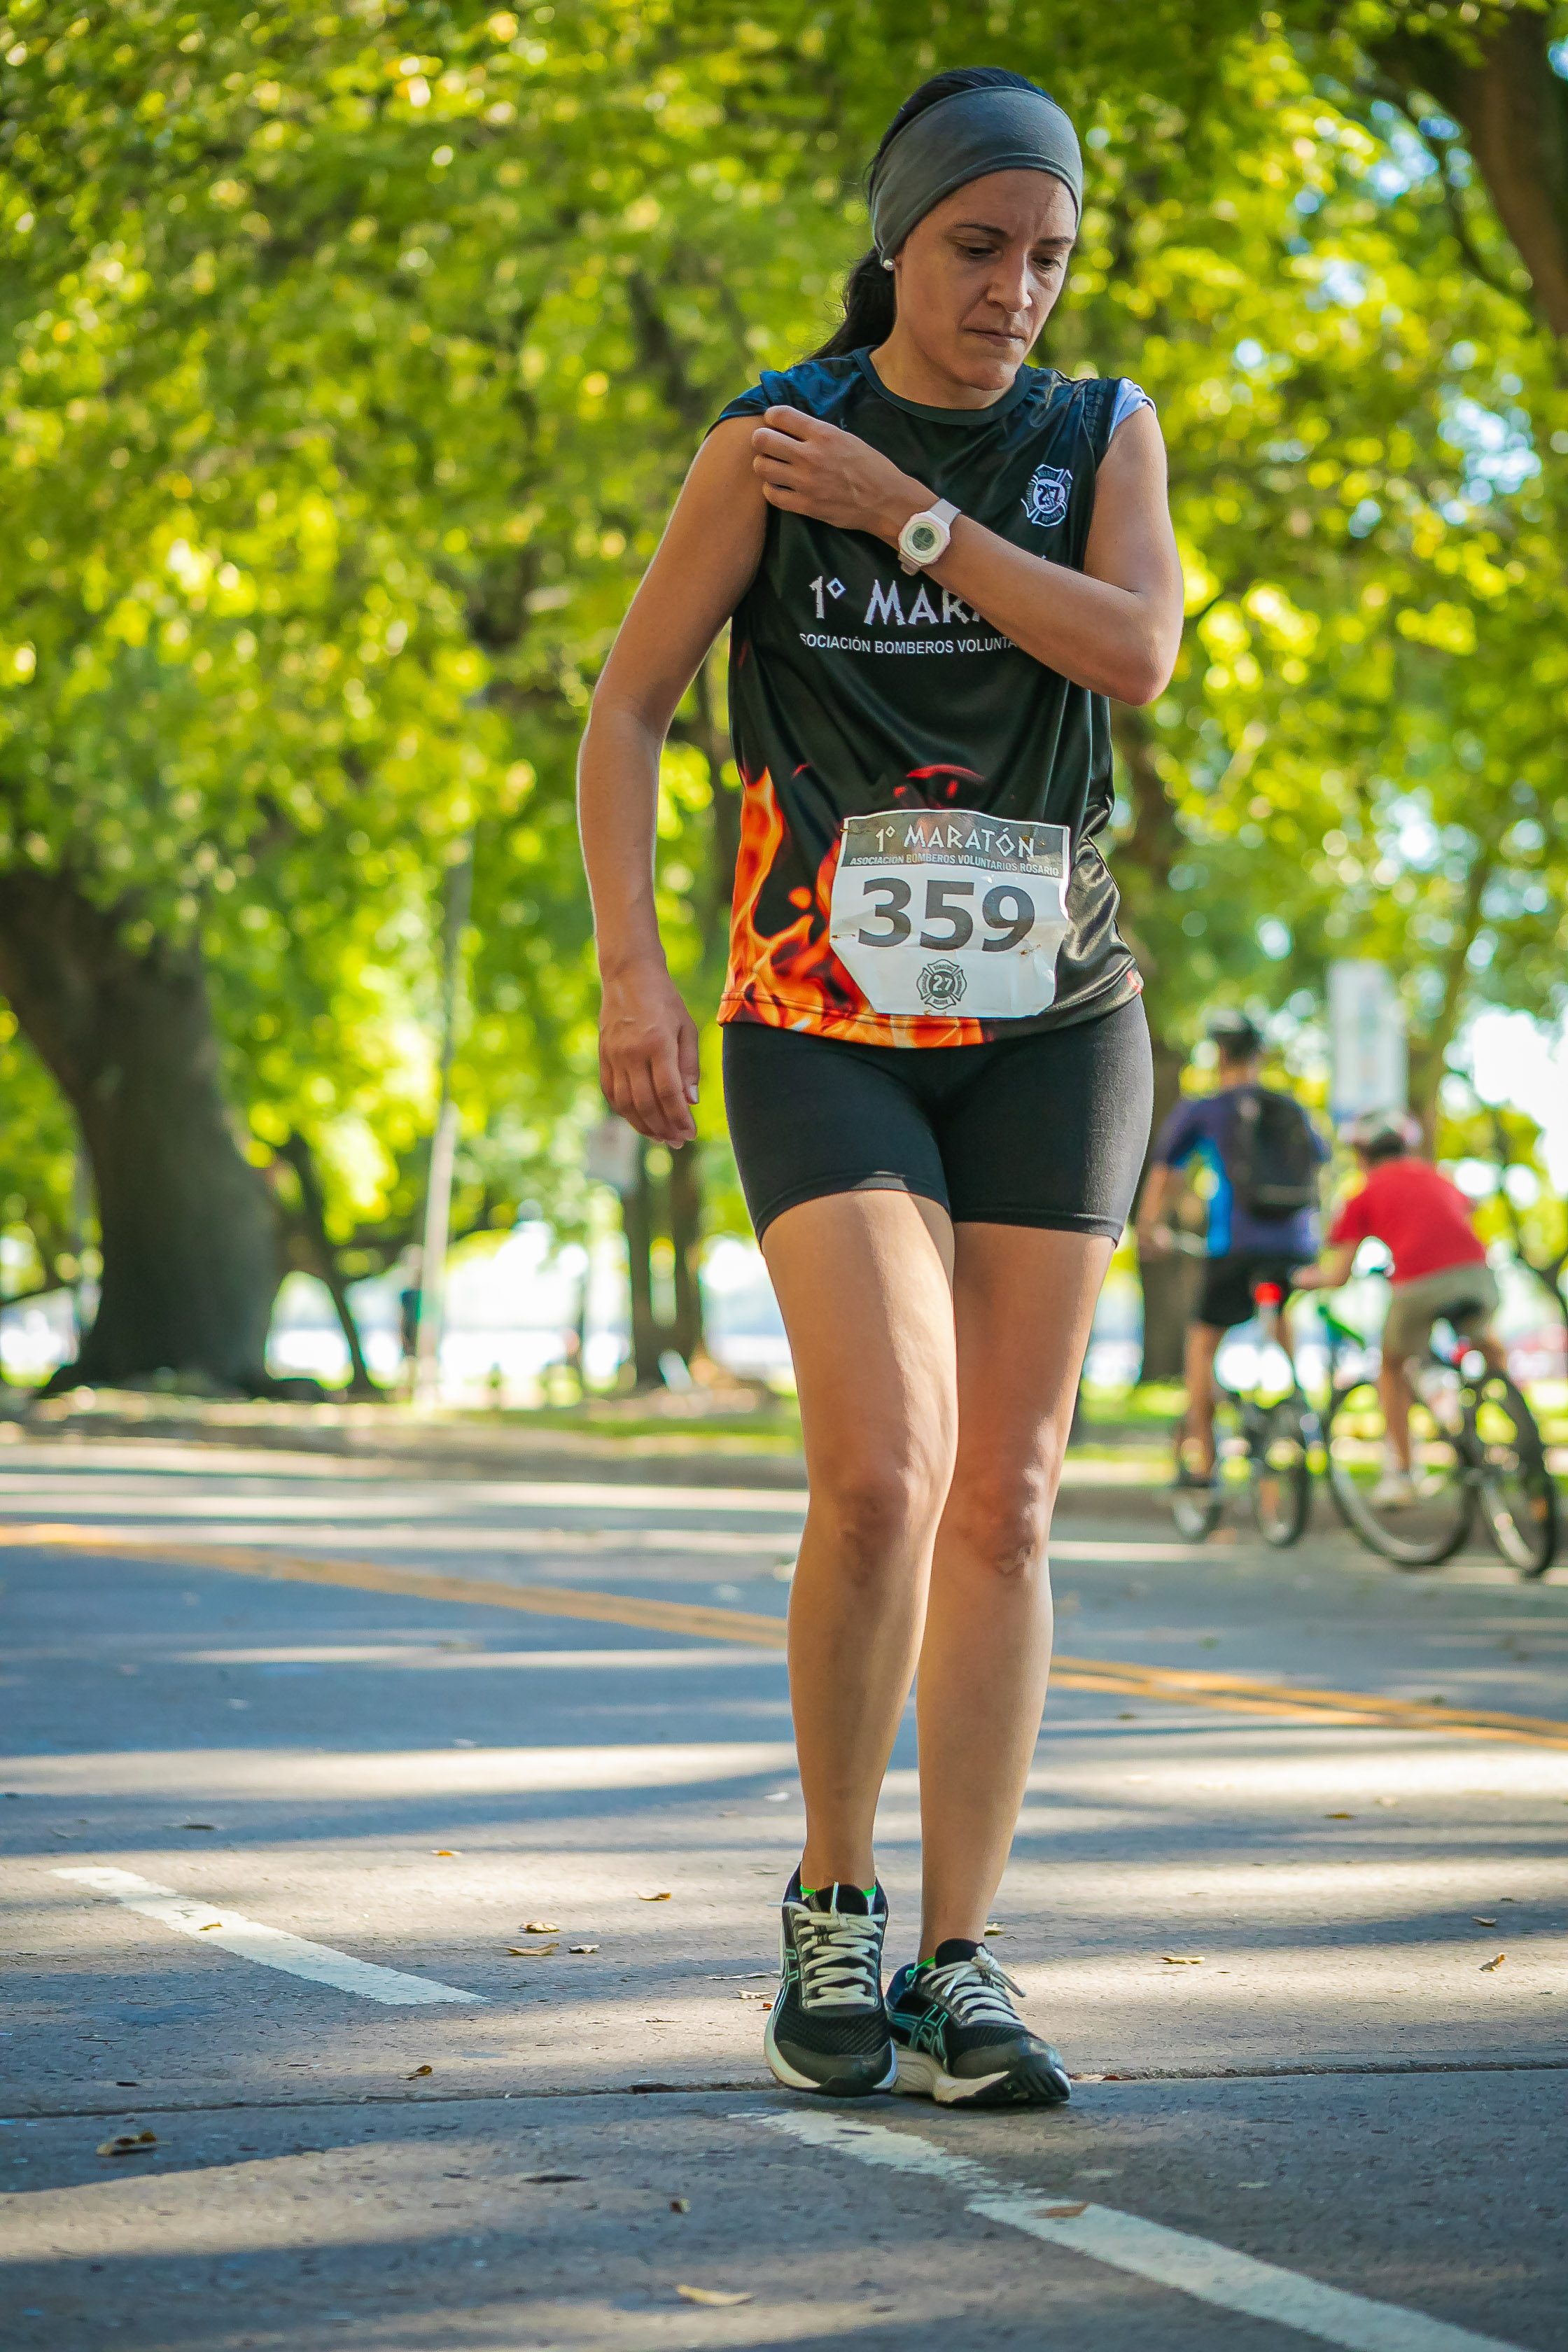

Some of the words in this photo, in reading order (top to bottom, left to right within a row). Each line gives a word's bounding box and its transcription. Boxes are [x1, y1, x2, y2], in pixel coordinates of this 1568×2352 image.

[874, 640, 953, 654] BOMBEROS
[903, 824, 1035, 858] MARATÓN
[906, 853, 955, 864] BOMBEROS
[958, 854, 1017, 872] VOLUNTARIOS
[1019, 862, 1059, 876] ROSARIO
[858, 878, 1035, 952] 359
[932, 974, 953, 992] 27
